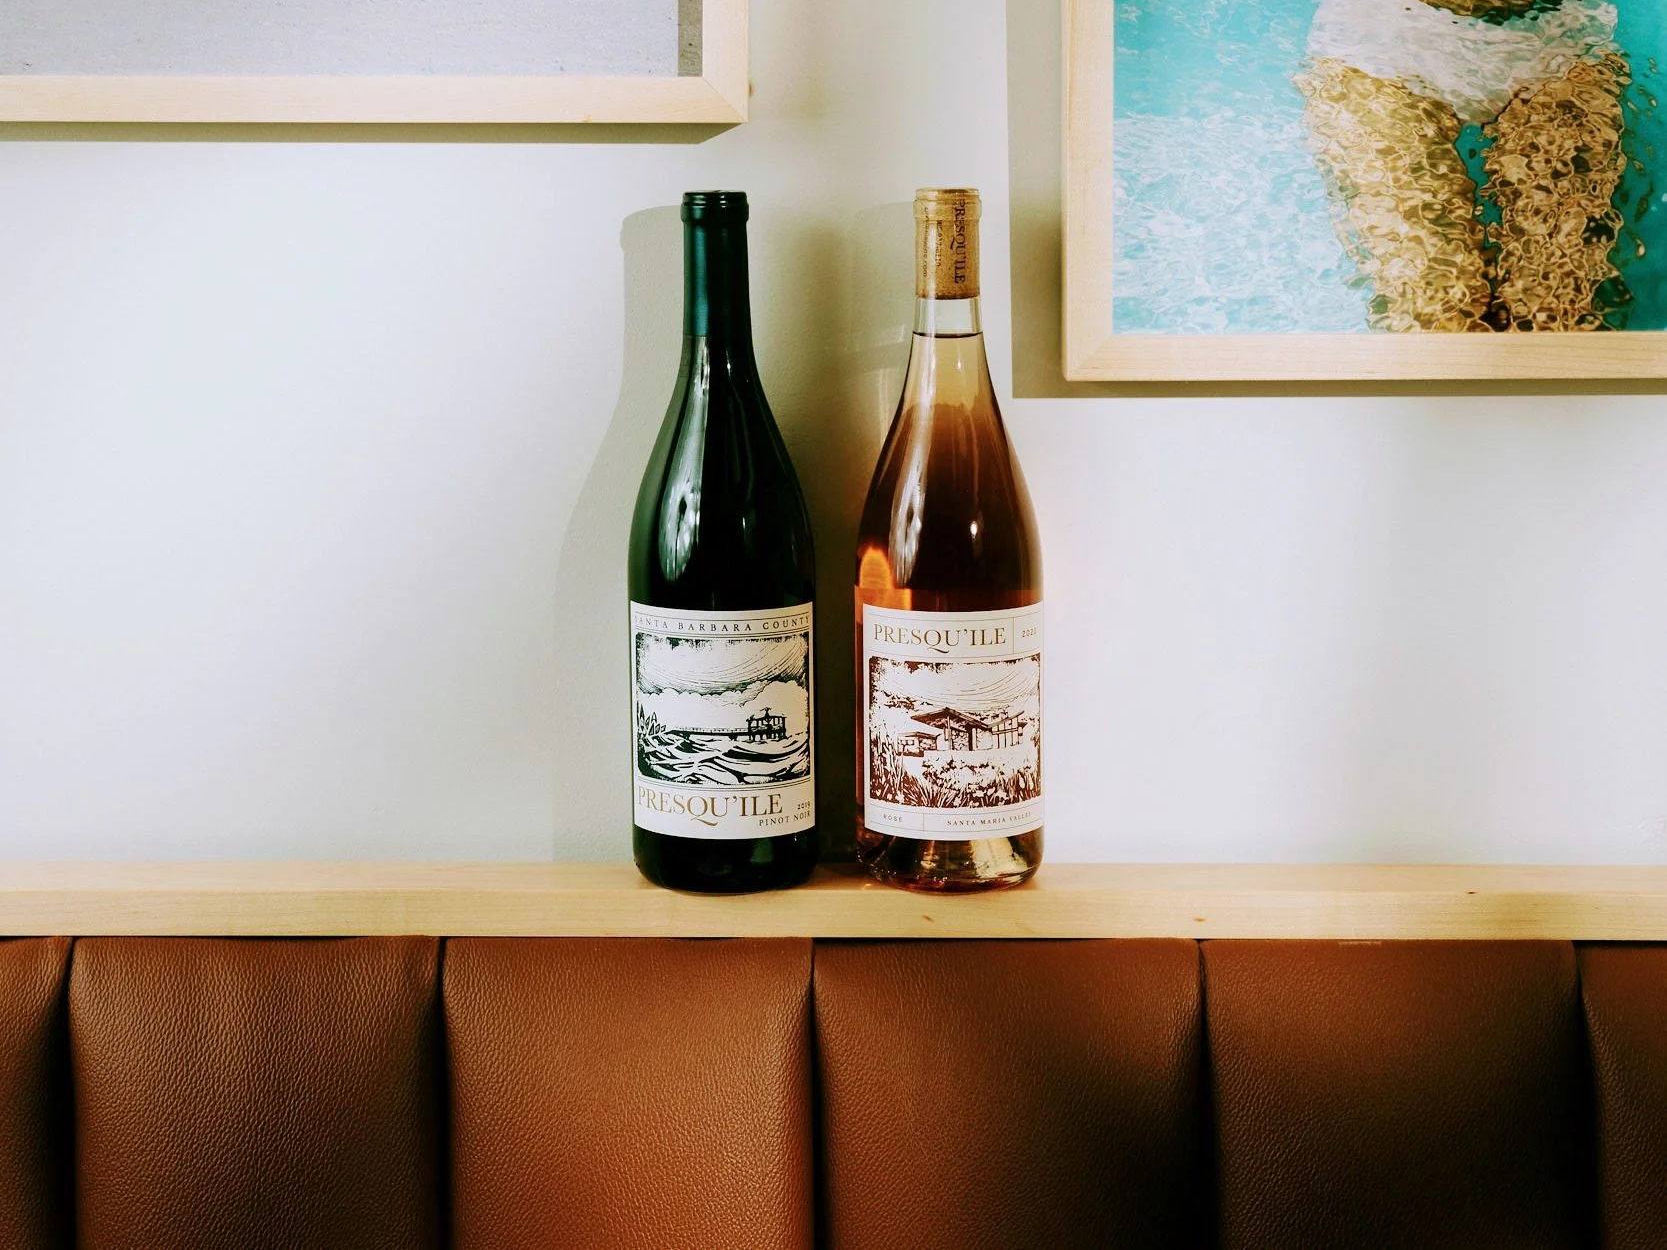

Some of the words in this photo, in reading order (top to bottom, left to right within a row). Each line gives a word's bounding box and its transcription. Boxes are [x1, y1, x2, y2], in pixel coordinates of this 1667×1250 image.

[678, 622, 752, 632] BARBARA
[762, 616, 809, 630] COUNTY
[874, 623, 1006, 654] PRESQU'ILE
[638, 786, 783, 827] PRESQU'ILE
[759, 816, 790, 827] PINOT
[793, 810, 811, 822] NOIR
[980, 817, 1006, 825] MARIA
